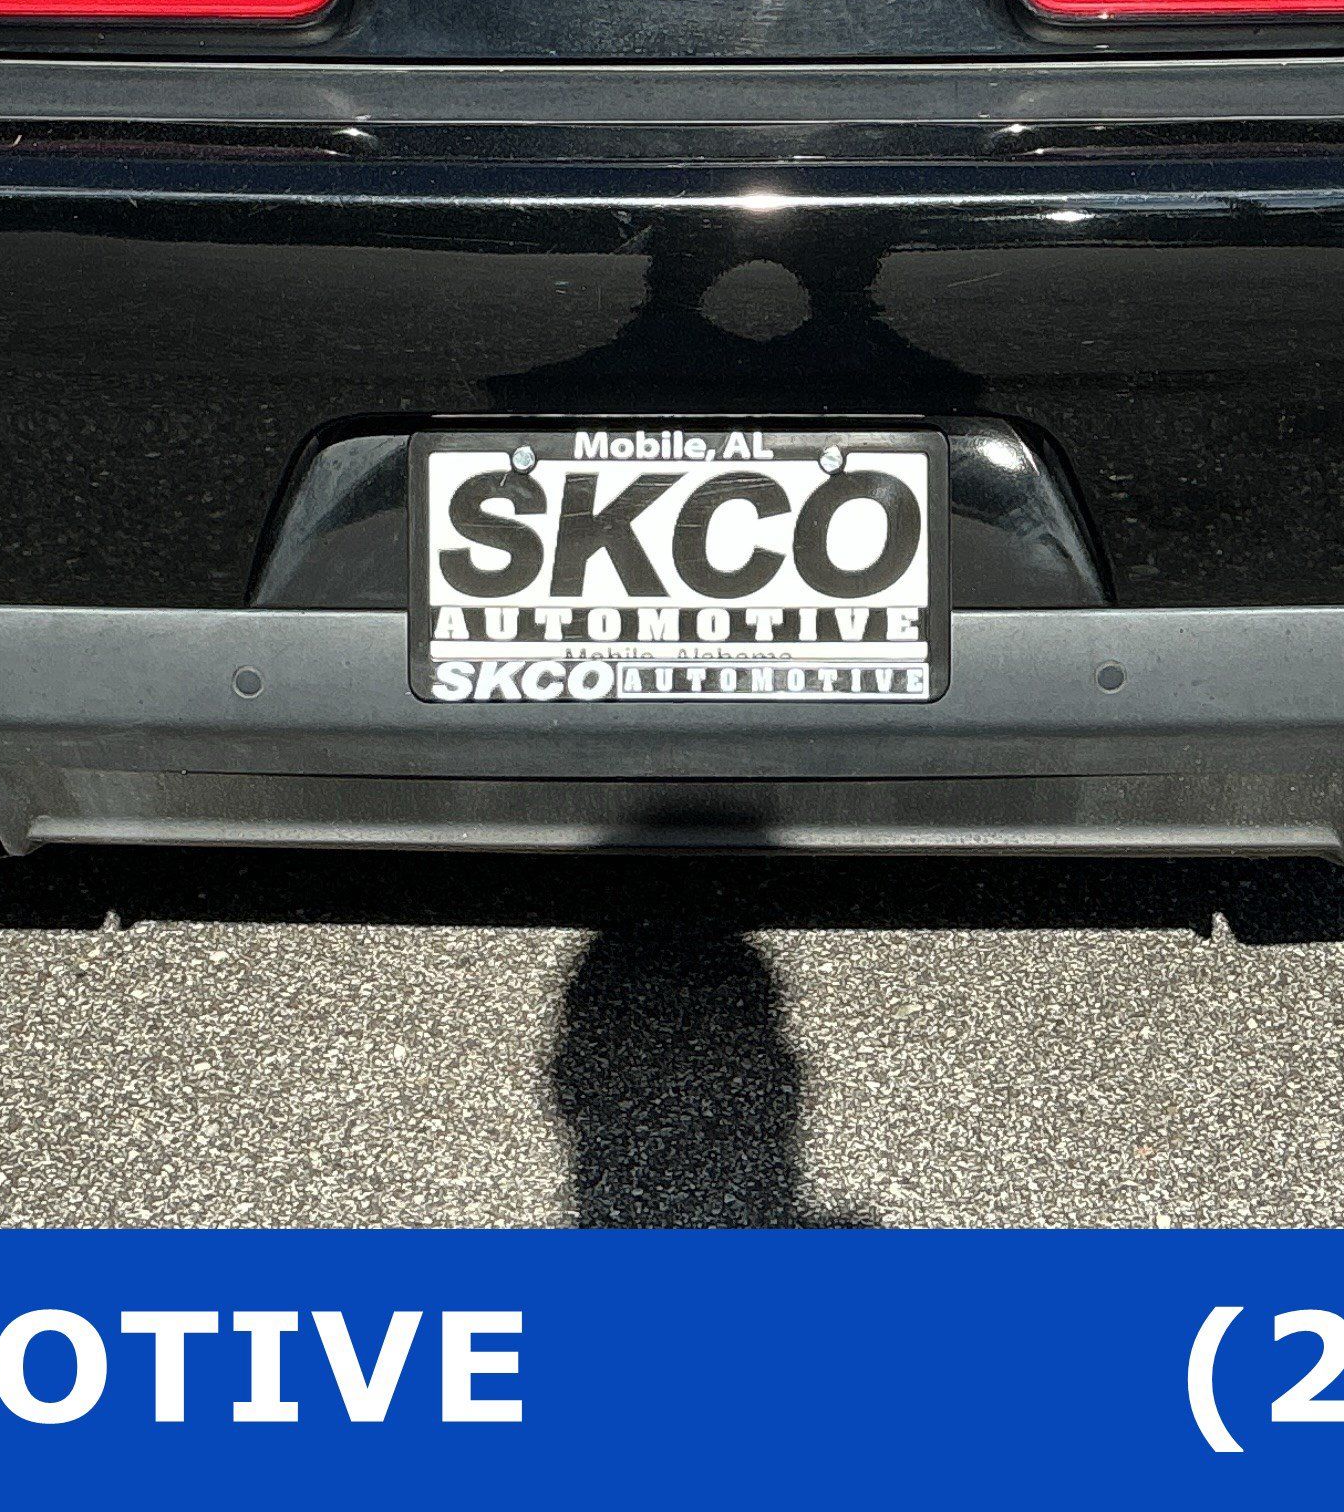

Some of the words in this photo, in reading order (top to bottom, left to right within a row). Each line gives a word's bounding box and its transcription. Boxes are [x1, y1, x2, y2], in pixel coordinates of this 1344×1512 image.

[573, 431, 716, 461] Mobile,
[721, 431, 775, 459] AL
[439, 469, 922, 599] SKCO
[434, 606, 921, 641] AUTOMOTIVE
[431, 660, 616, 701] SKCO
[622, 667, 925, 693] AUTOMOTIVE
